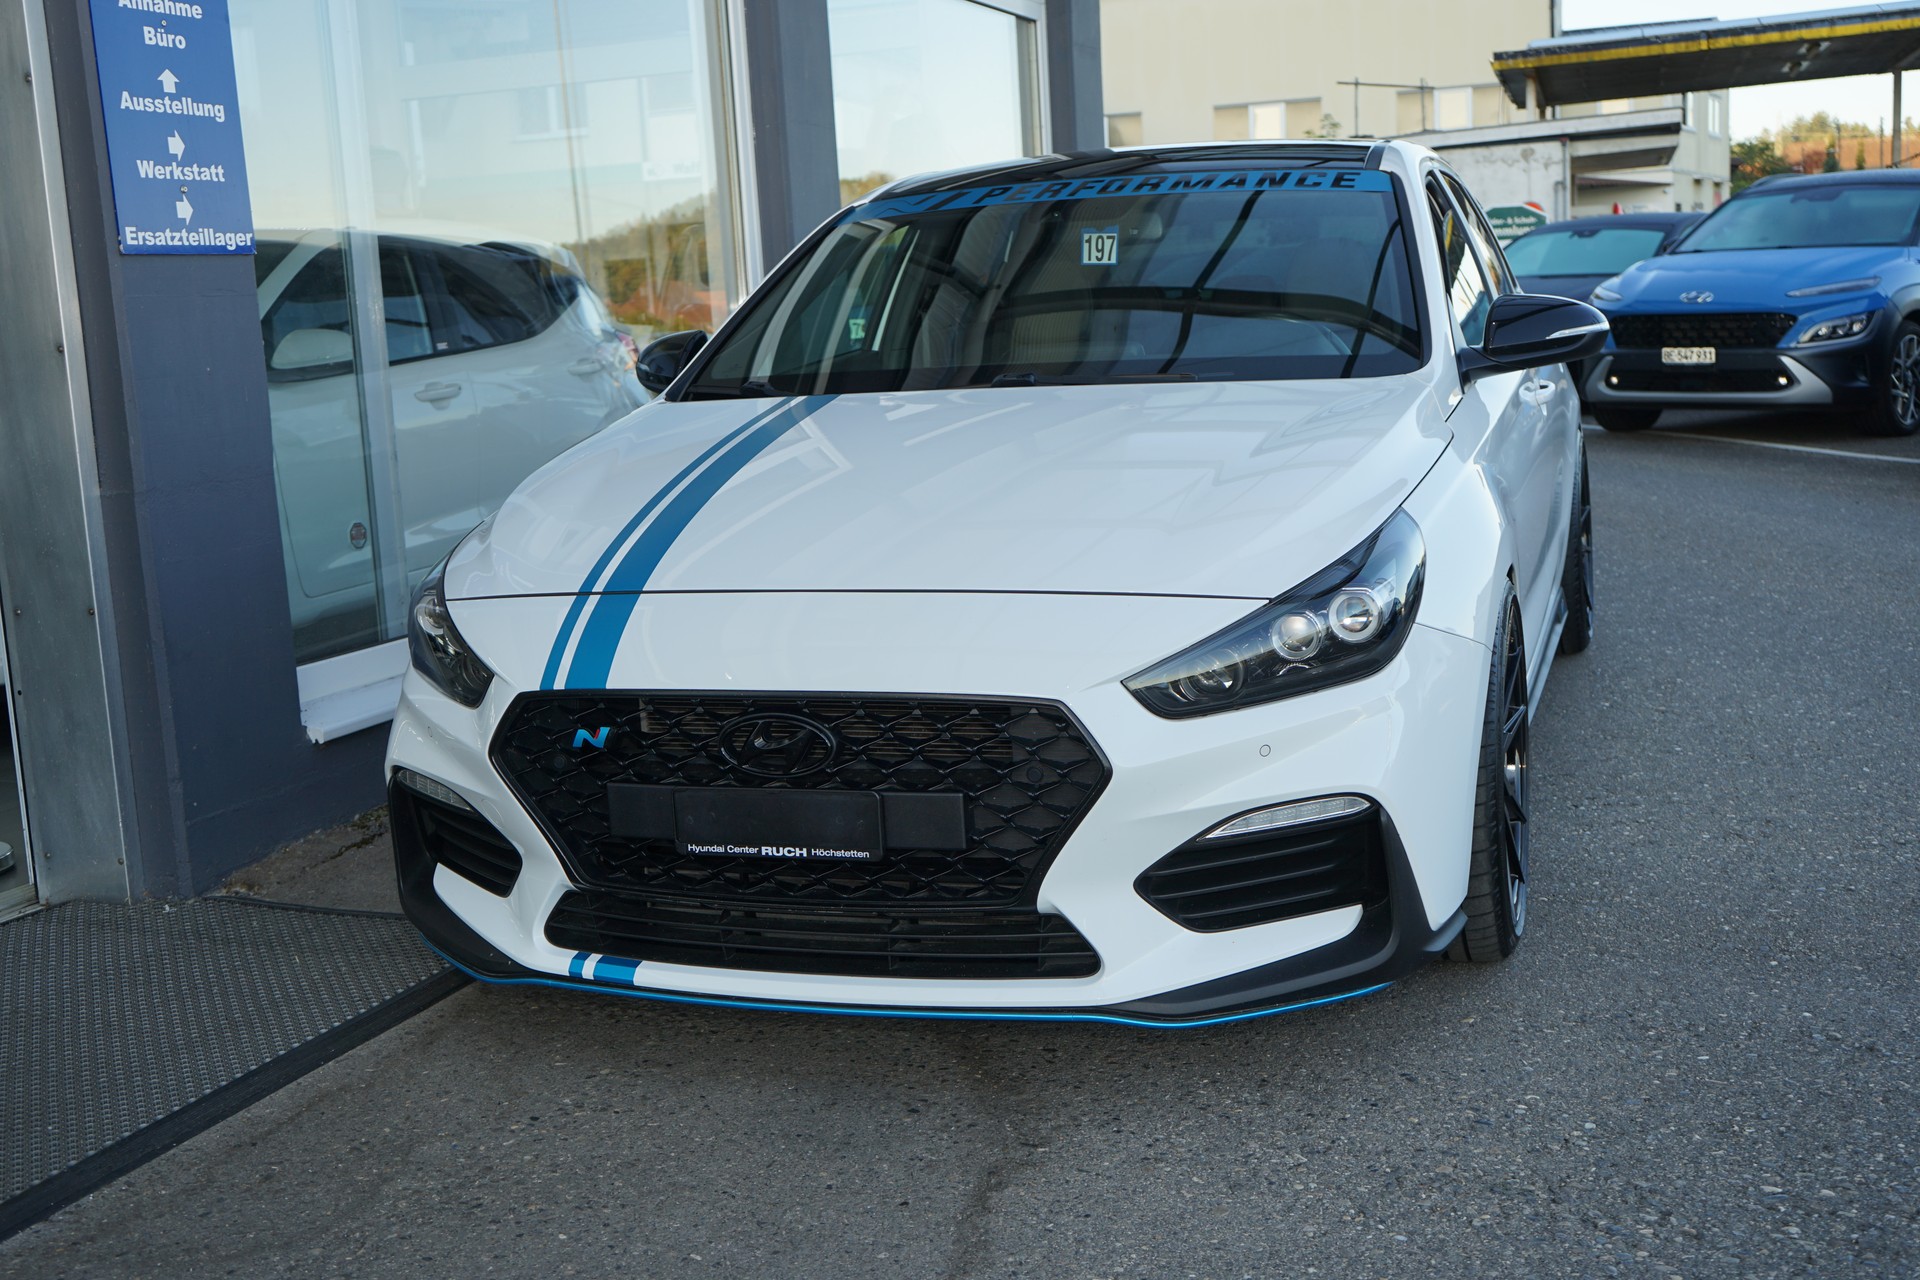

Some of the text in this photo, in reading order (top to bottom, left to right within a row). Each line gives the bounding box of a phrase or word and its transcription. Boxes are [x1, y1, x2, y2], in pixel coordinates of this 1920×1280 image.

[143, 26, 187, 49] Büro
[120, 91, 226, 122] Ausstellung
[136, 159, 226, 182] Werkstatt
[972, 171, 1362, 206] PERFORMANCE
[125, 226, 254, 250] Ersatzteillager
[1084, 234, 1117, 262] 197
[687, 843, 871, 859] Hyundai Center RUCH Höchstetten
